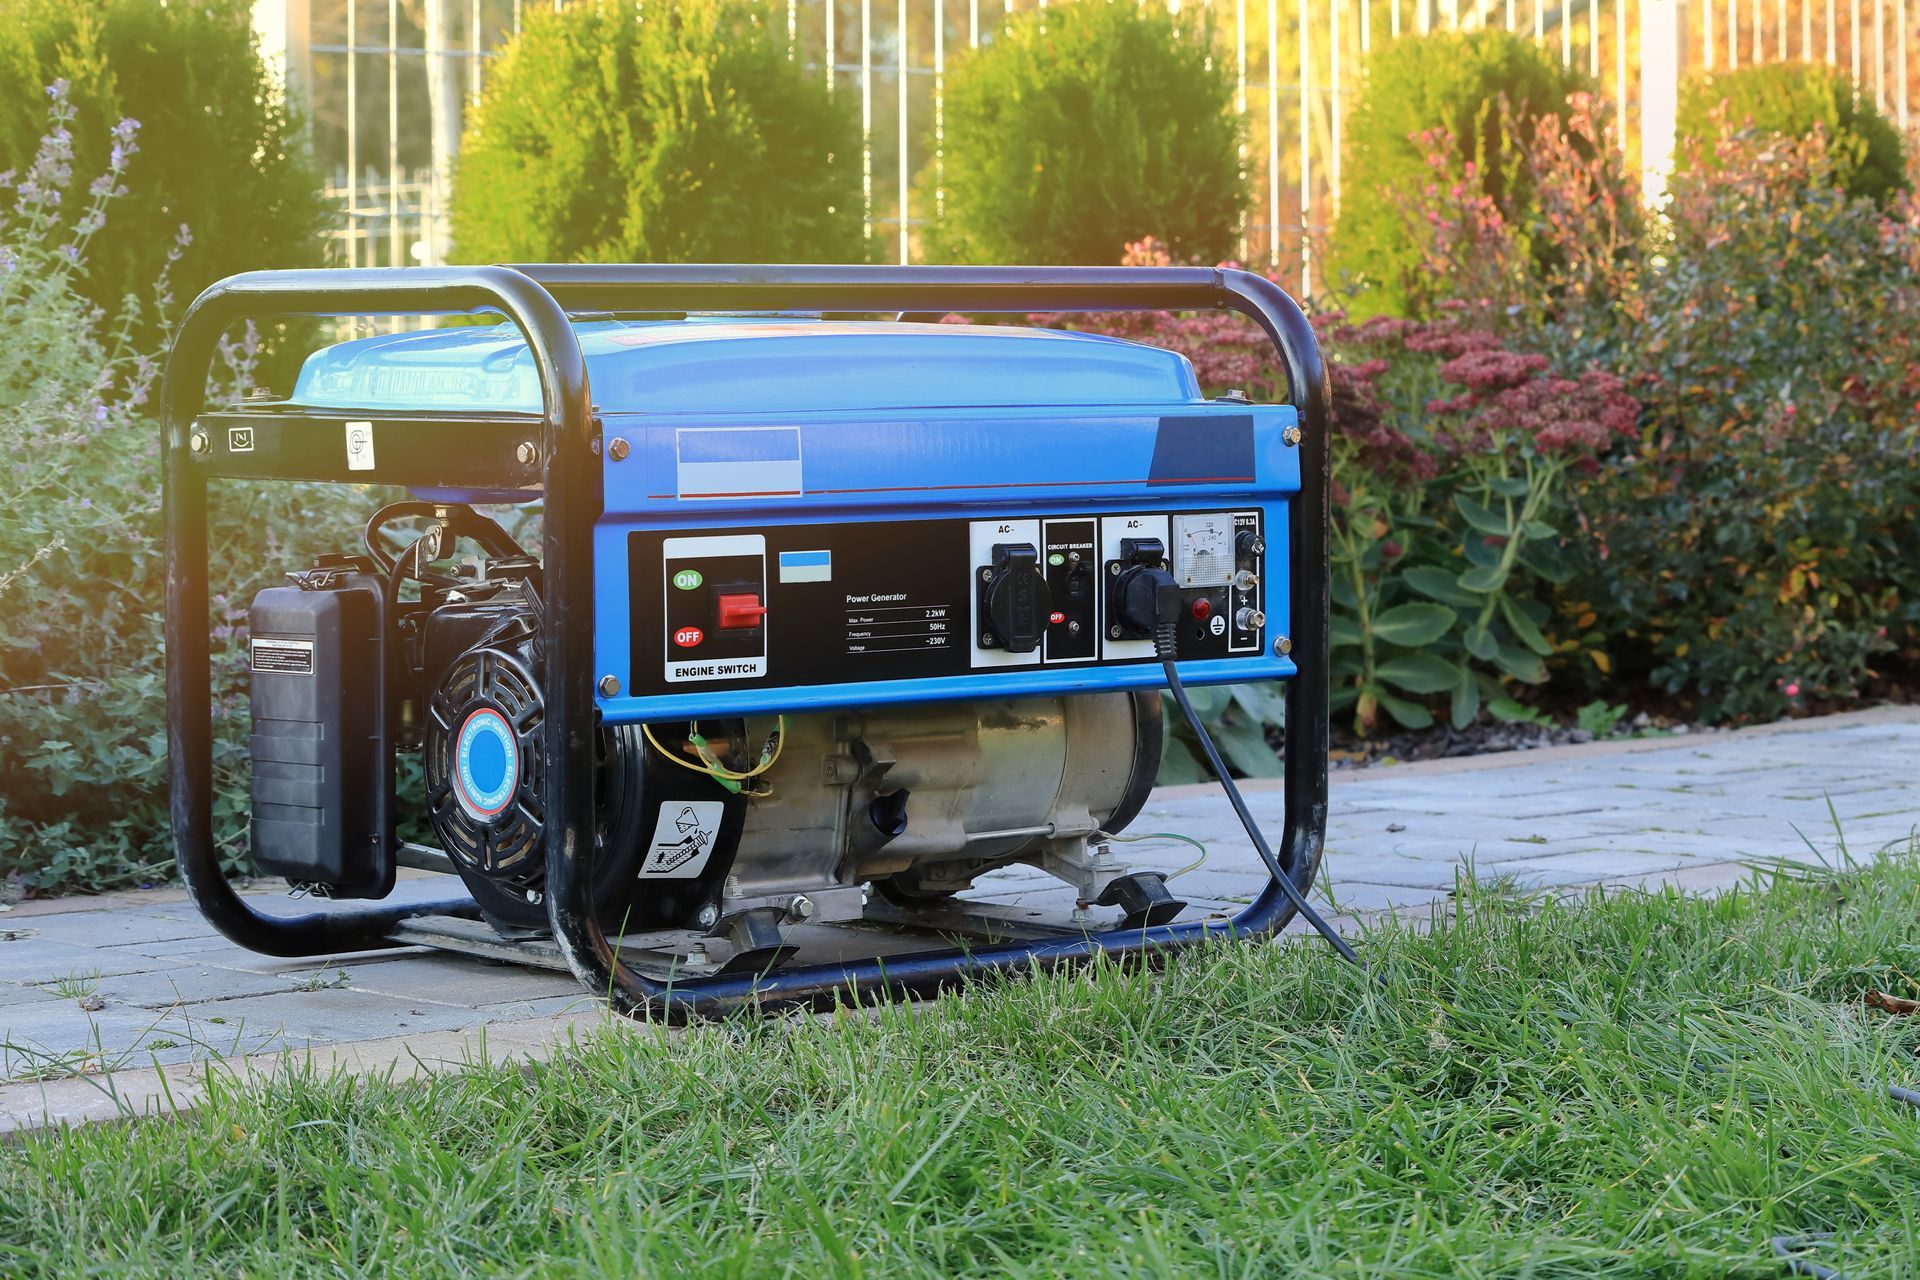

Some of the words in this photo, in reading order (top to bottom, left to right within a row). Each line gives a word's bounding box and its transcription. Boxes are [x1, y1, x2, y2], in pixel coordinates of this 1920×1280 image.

[677, 574, 697, 586] ON
[846, 595, 869, 603] Power
[870, 593, 907, 602] Generator
[925, 609, 946, 617] 2.2kW
[677, 632, 699, 643] OFF
[675, 666, 715, 677] ENGINE
[717, 664, 757, 674] SWITCH
[461, 718, 491, 757] ELECTRONIC
[492, 720, 513, 757] IGNITION
[462, 766, 482, 803] IGNITION
[483, 765, 513, 806] ELECTRONIC
